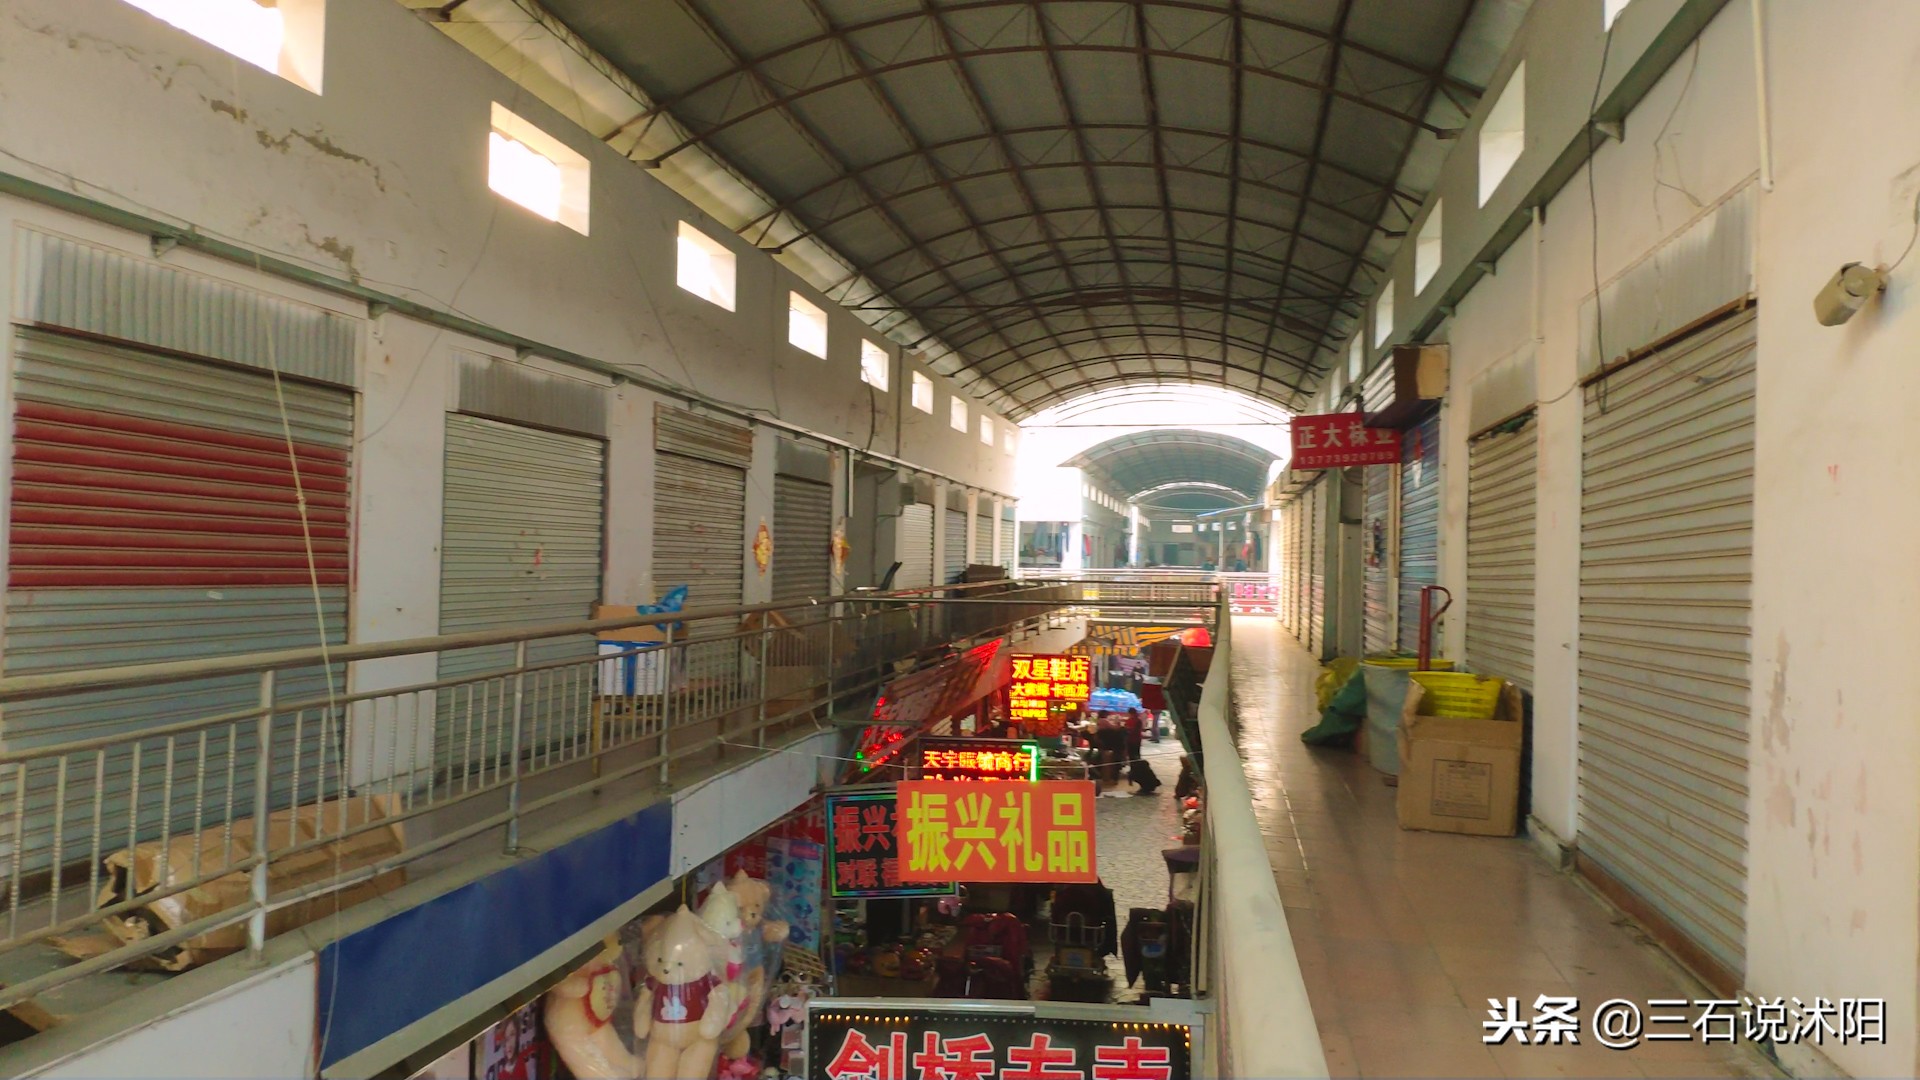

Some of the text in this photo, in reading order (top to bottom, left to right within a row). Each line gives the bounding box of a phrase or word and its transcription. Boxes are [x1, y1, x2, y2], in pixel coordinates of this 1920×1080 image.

[1297, 421, 1395, 449] 正大袜业
[1011, 658, 1089, 683] 双星鞋店
[923, 749, 1031, 772] 天宇眼镜商行
[834, 804, 898, 854] 振兴
[907, 791, 1089, 873] 振兴礼品
